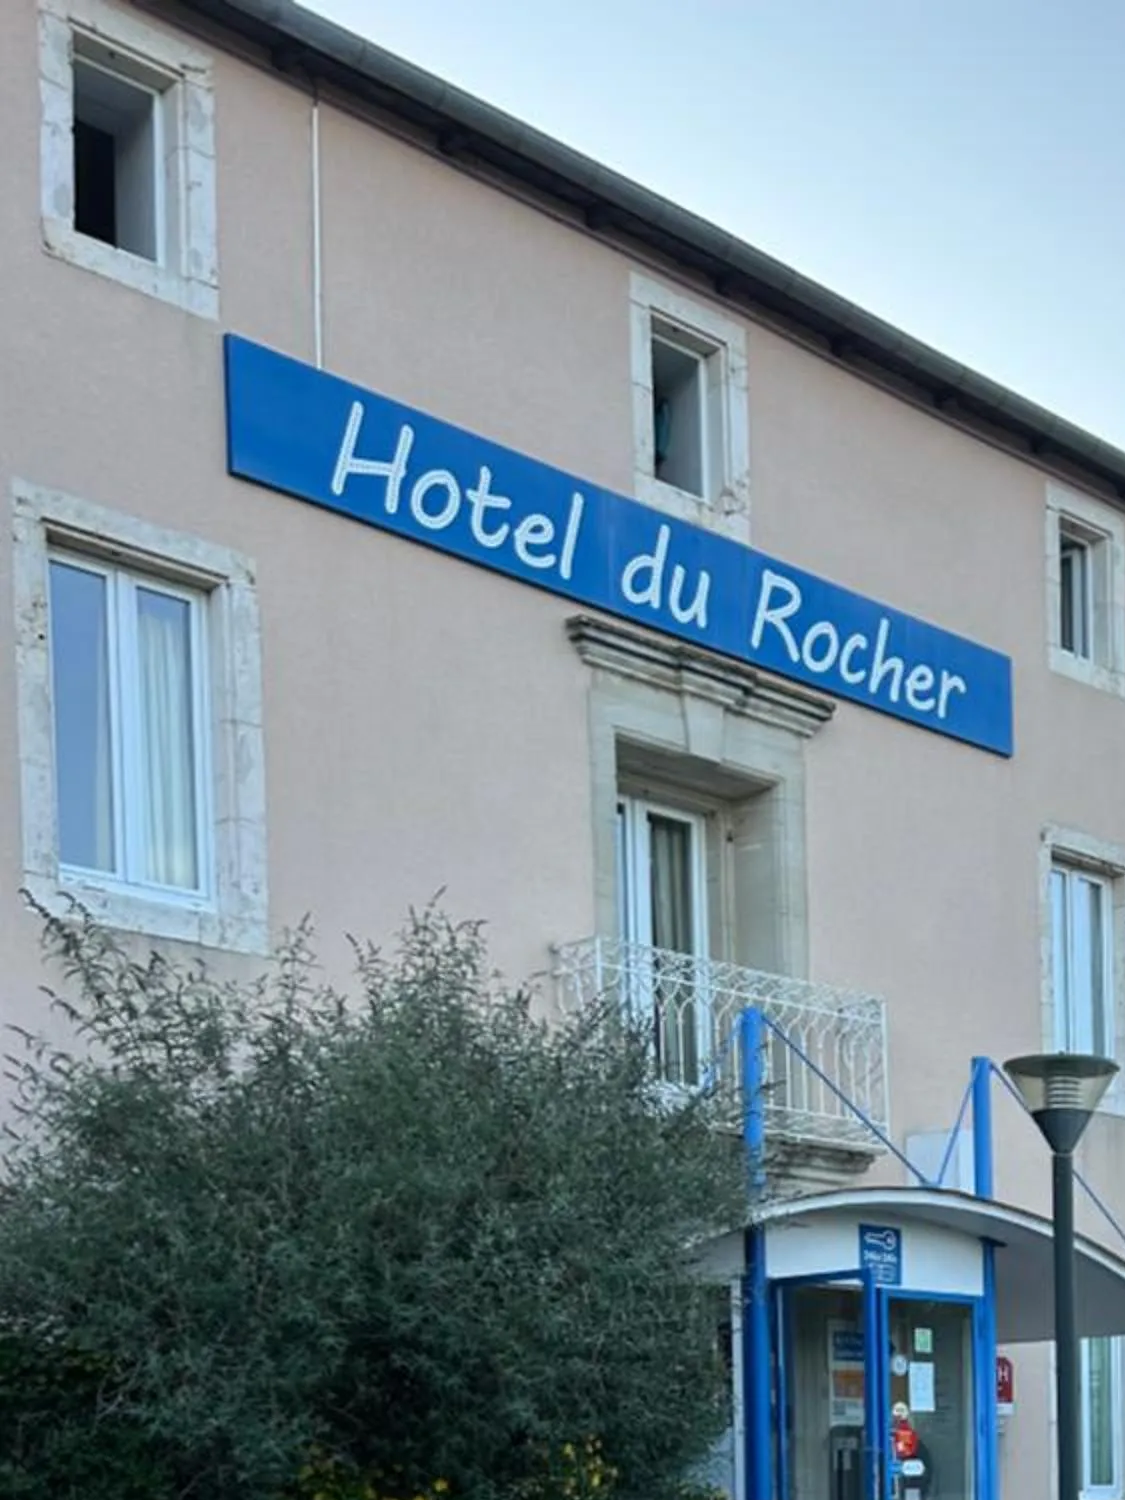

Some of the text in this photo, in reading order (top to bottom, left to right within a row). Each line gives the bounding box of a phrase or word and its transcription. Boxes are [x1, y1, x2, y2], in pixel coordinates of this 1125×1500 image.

[331, 402, 967, 719] Hotel du Rocher
